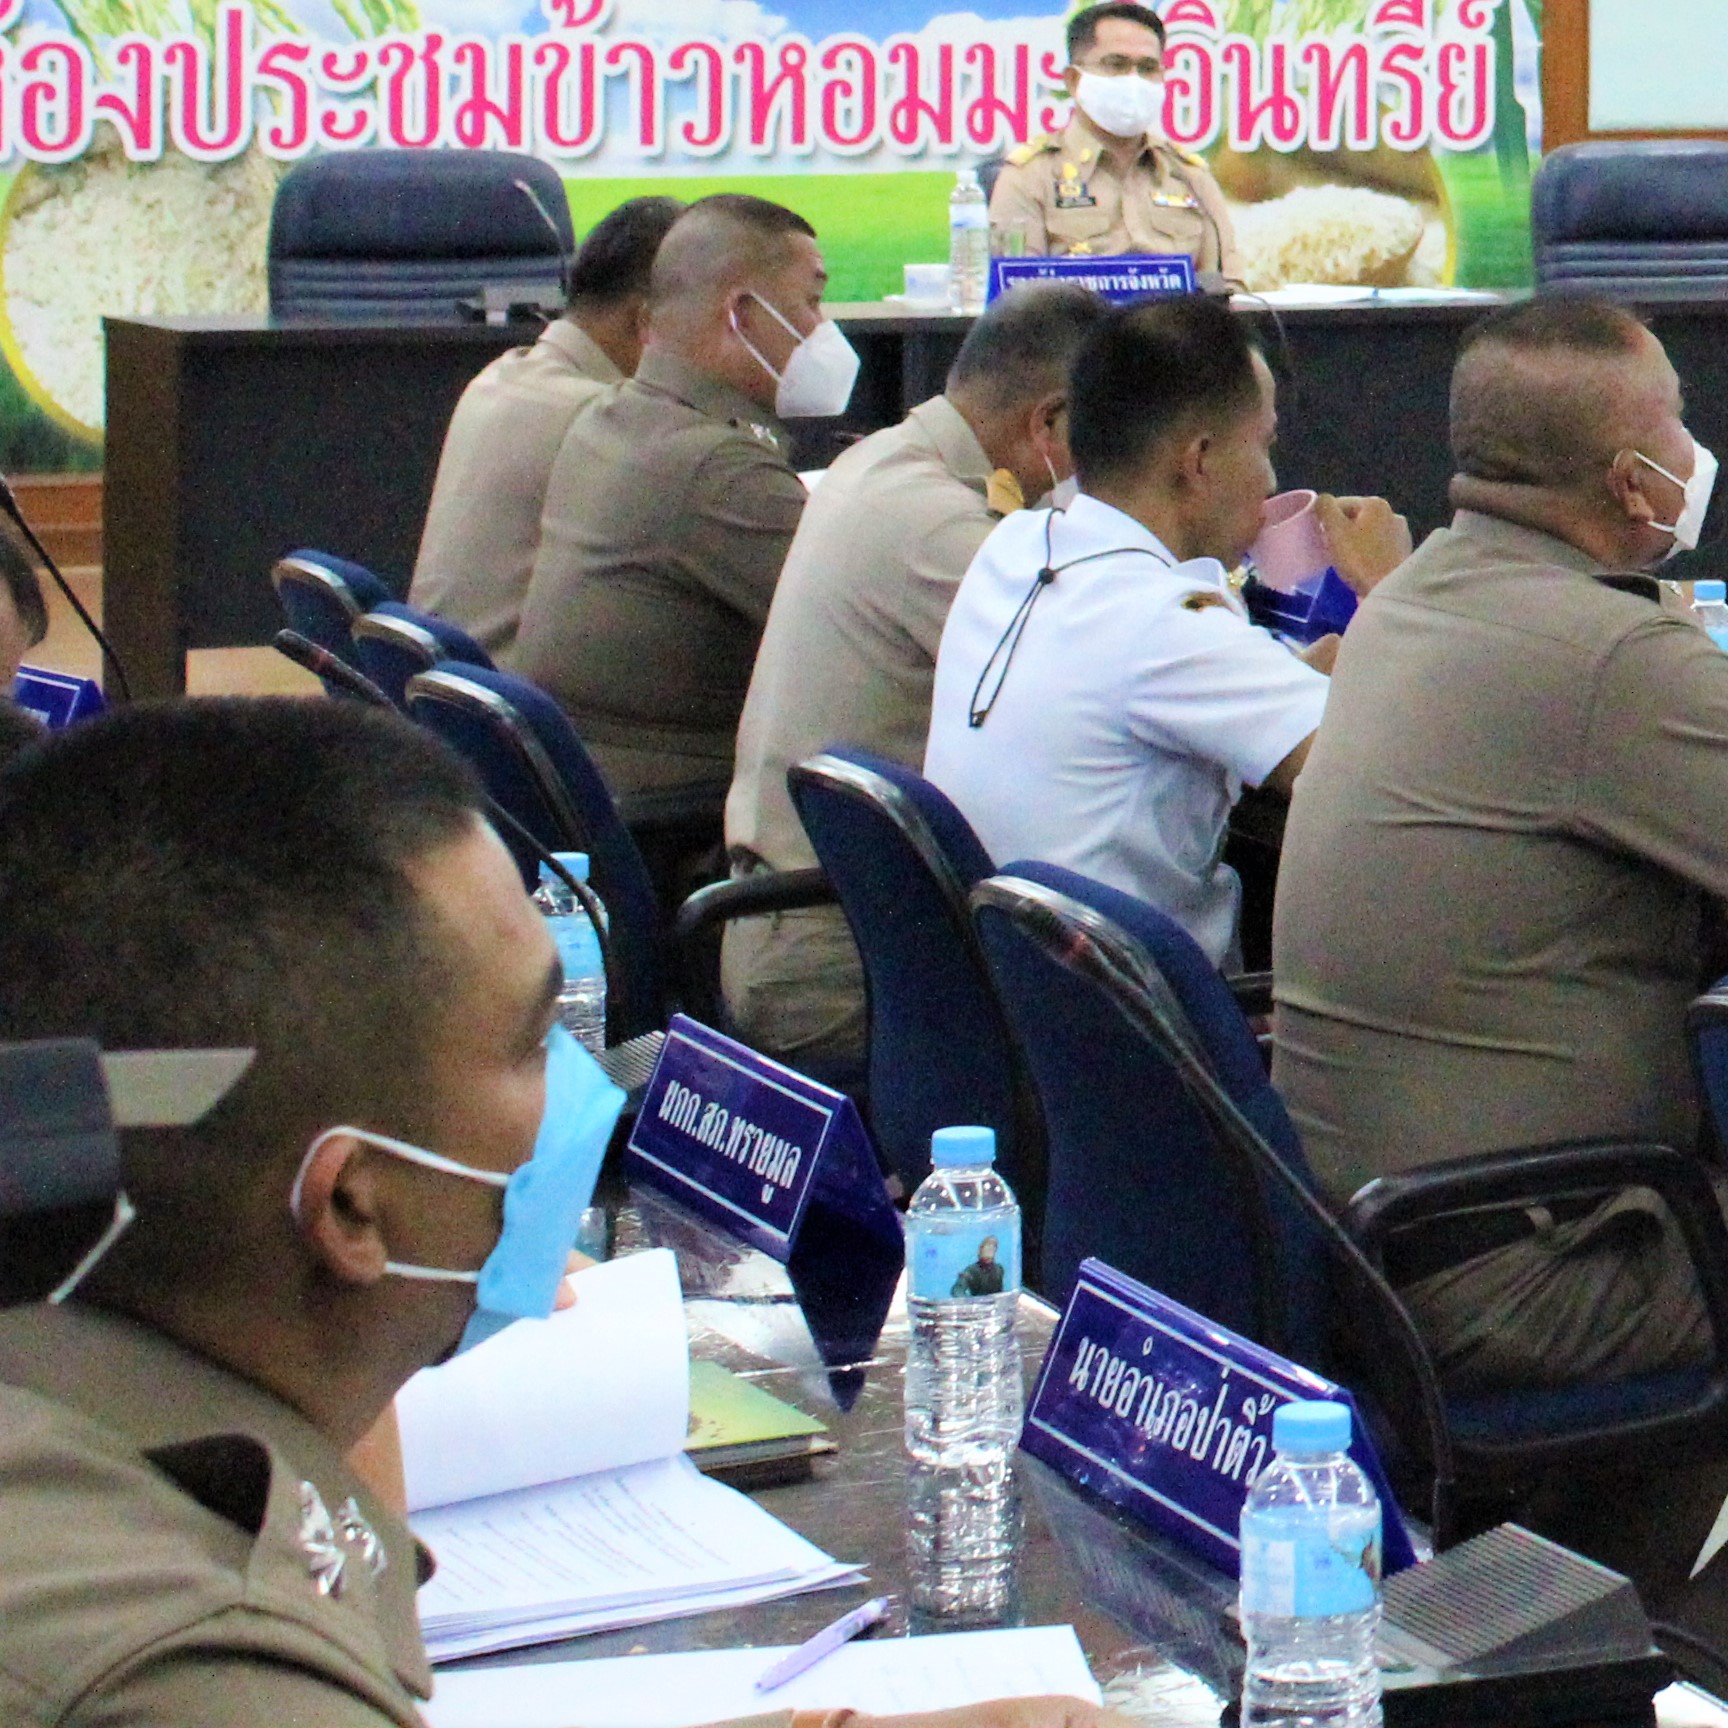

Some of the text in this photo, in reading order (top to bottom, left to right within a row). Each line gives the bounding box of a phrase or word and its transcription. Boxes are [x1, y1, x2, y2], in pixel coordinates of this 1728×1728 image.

[658, 1079, 802, 1204] ผกก.สภ.ทรายมูล
[1068, 1334, 1276, 1487] นายอำเภอป่าติ้ว
